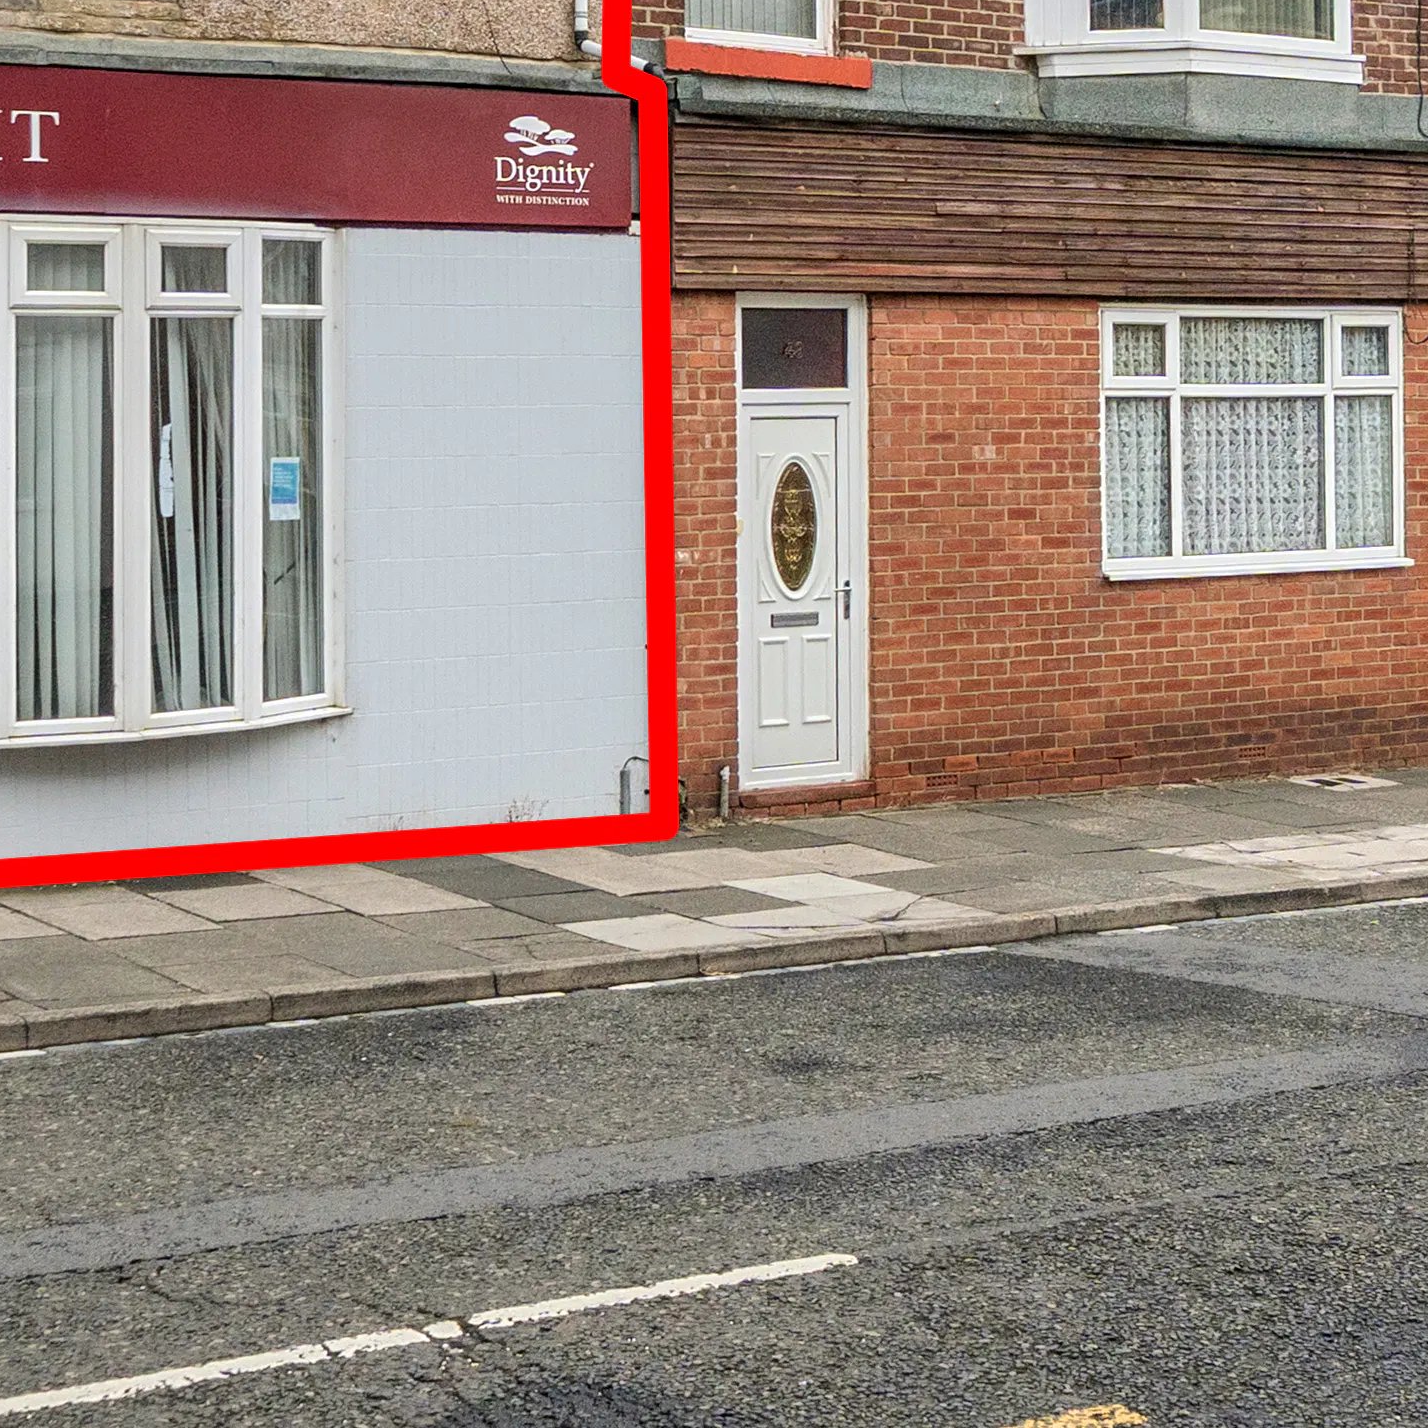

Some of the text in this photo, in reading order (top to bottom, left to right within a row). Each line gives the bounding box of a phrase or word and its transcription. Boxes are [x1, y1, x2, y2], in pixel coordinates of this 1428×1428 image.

[494, 156, 594, 194] Dignity
[496, 194, 590, 206] WITH DISTINCTION
